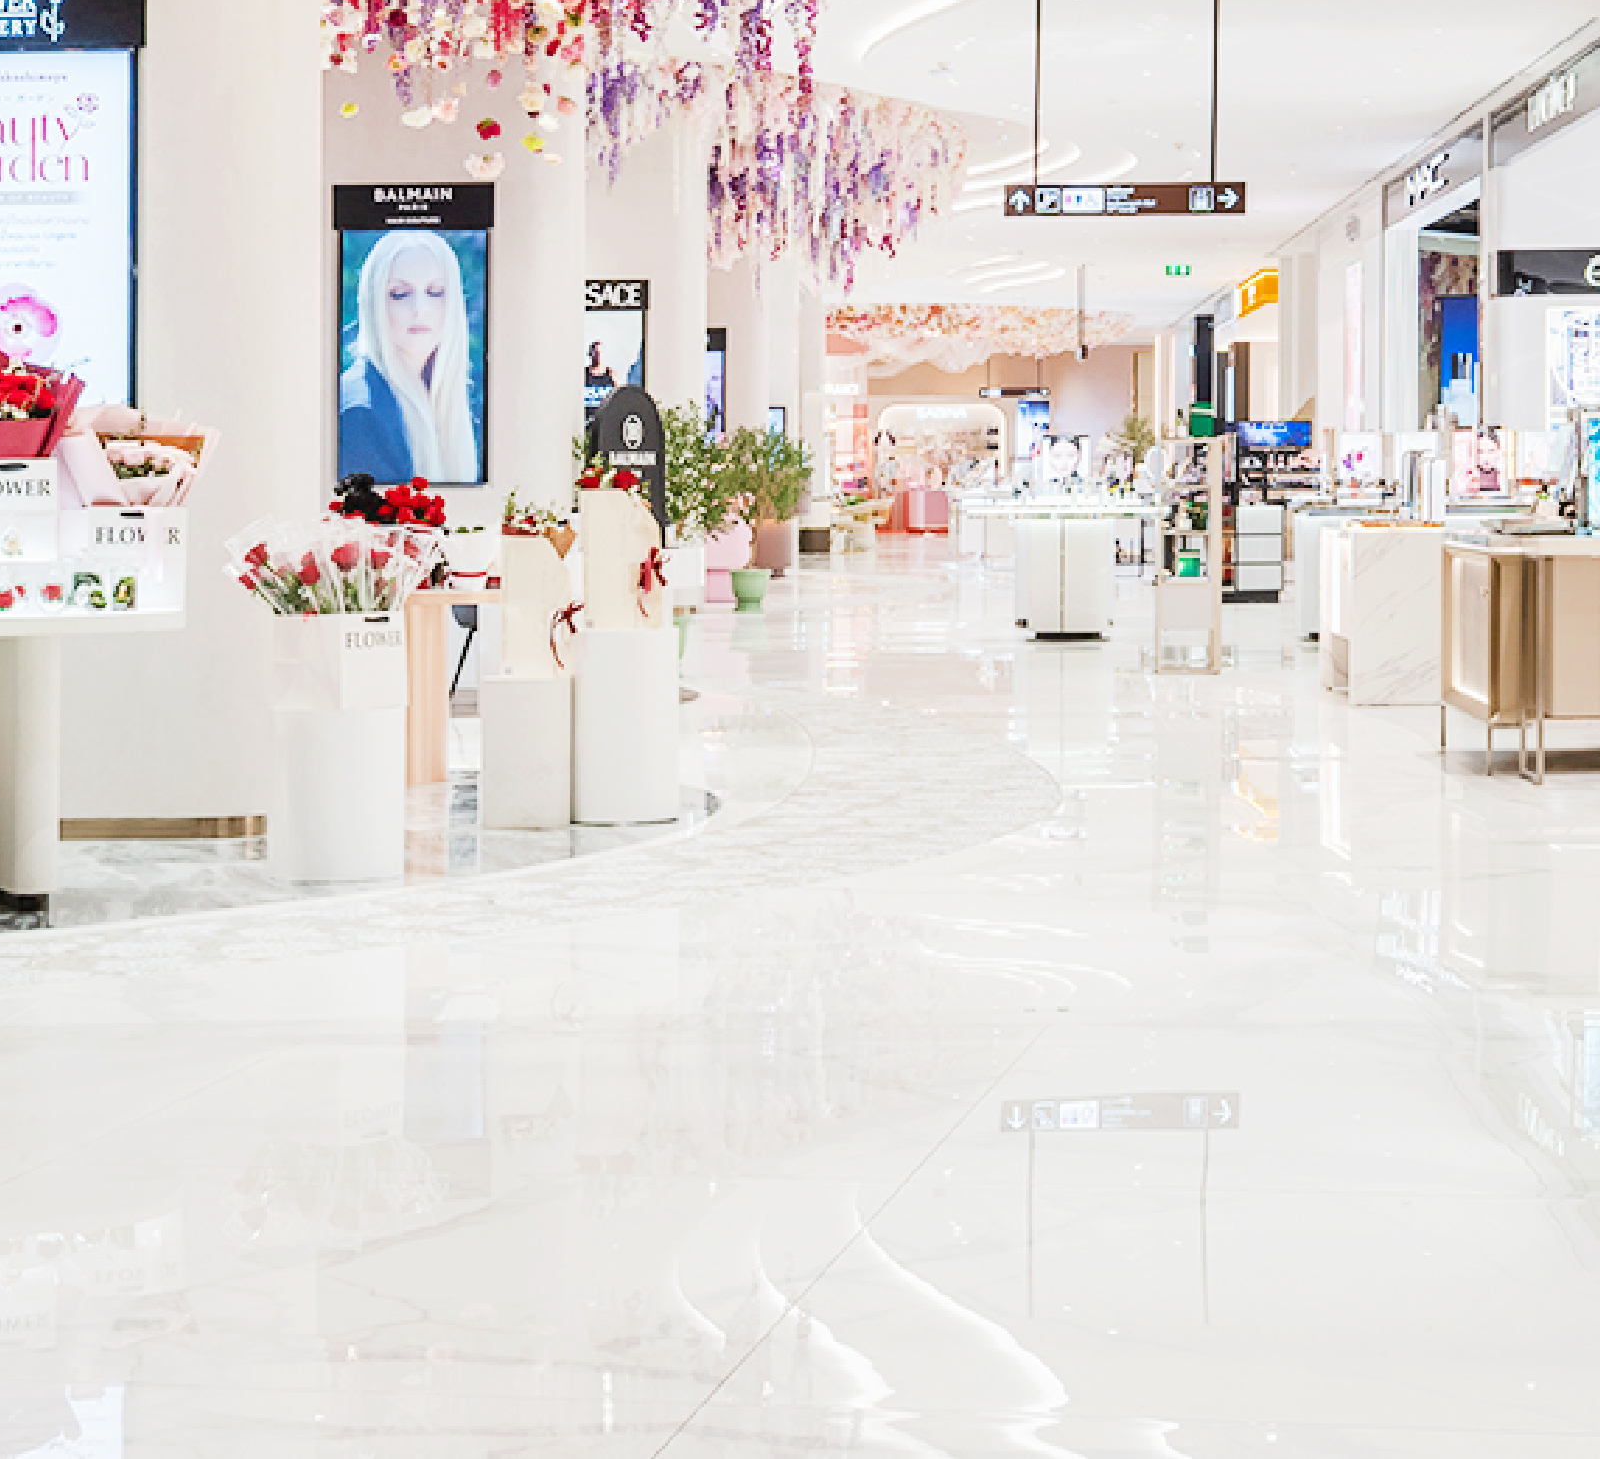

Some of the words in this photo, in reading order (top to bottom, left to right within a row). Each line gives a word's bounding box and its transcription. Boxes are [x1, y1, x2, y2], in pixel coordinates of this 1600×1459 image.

[373, 186, 454, 202] BALMAIN
[585, 282, 642, 307] SACE
[94, 526, 182, 545] FLOWR
